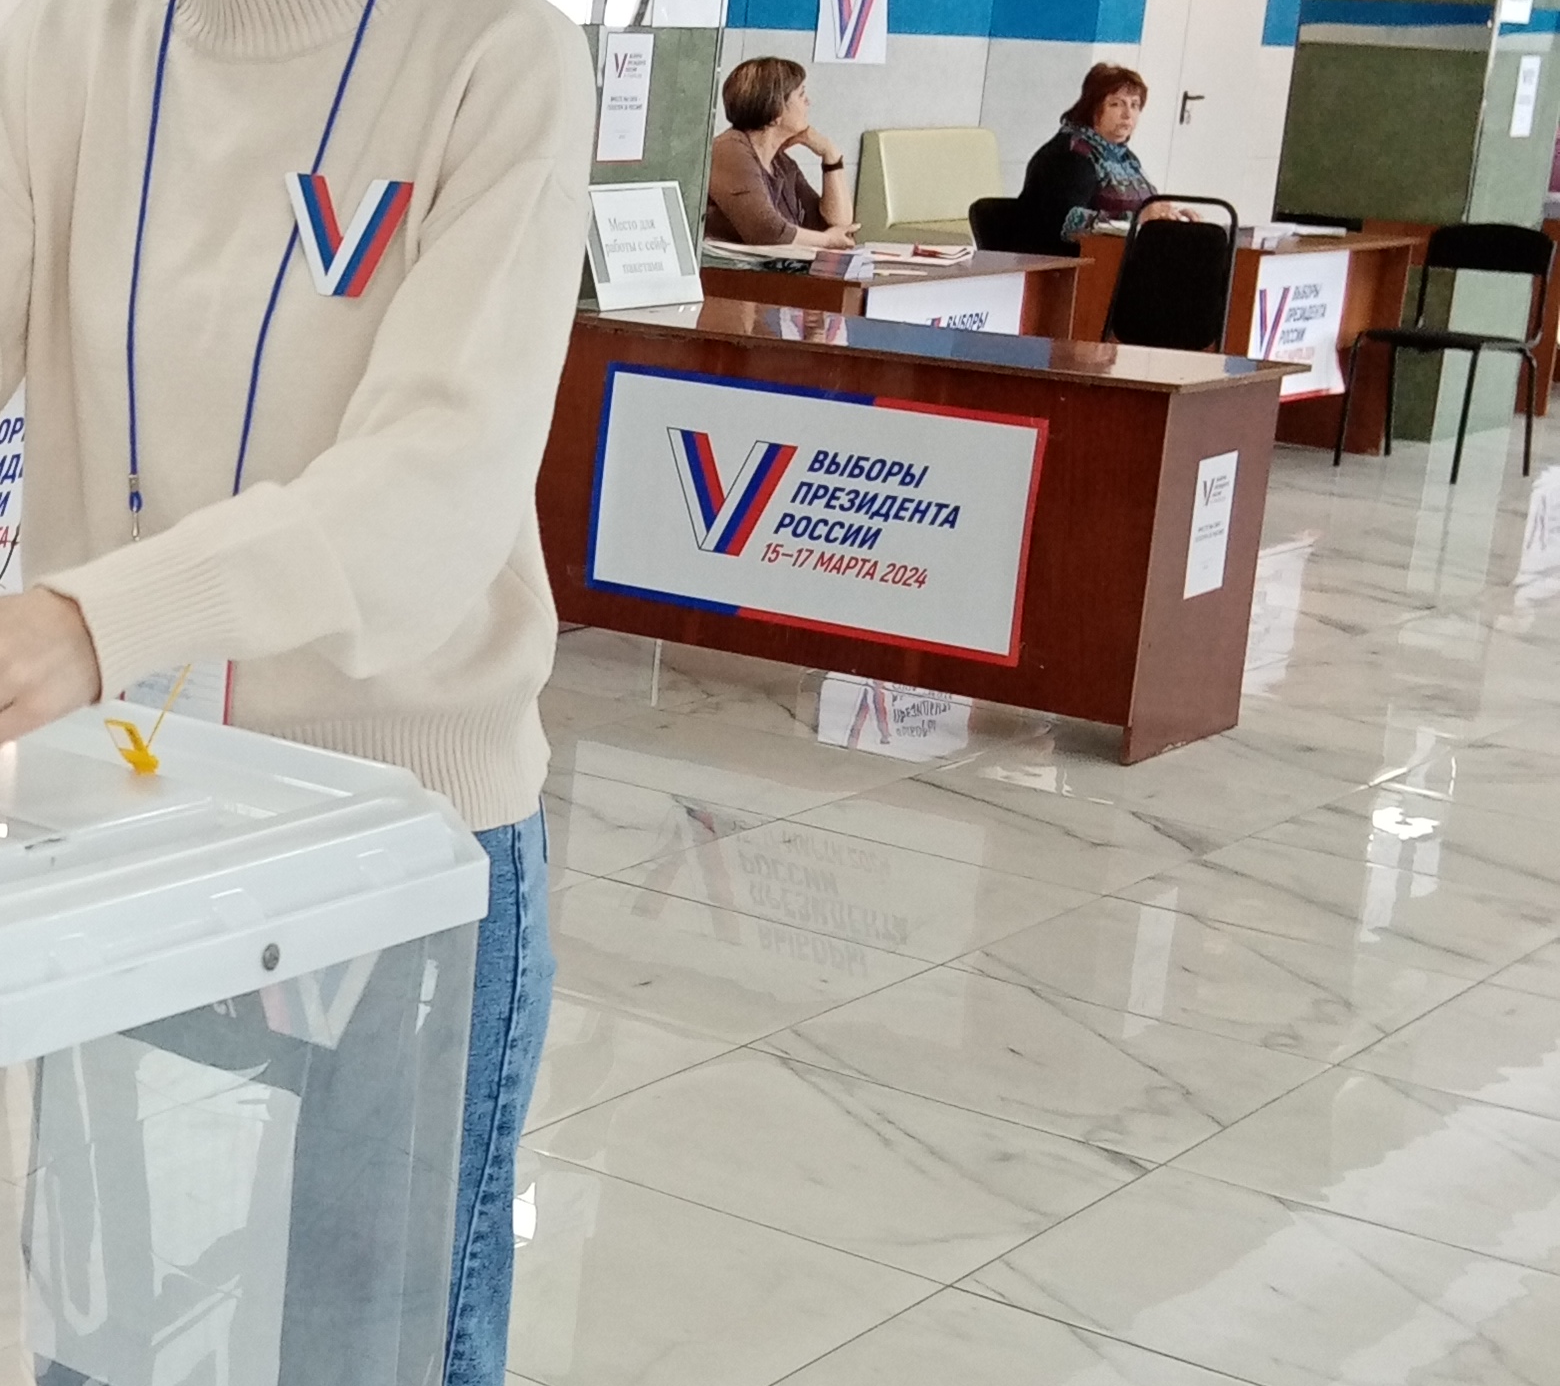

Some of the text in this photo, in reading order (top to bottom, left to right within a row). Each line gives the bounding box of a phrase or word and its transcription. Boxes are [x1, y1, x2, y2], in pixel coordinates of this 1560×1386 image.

[608, 217, 656, 231] Место для
[605, 238, 636, 257] работы
[945, 311, 989, 331] ВЫБОРЫ
[806, 449, 930, 489] ВЫБОРЫ
[789, 480, 961, 530] ПРЕЗИДЕНТА
[773, 512, 883, 551] РОССИИ
[812, 550, 880, 581] МАРТА
[879, 562, 929, 589] 2024
